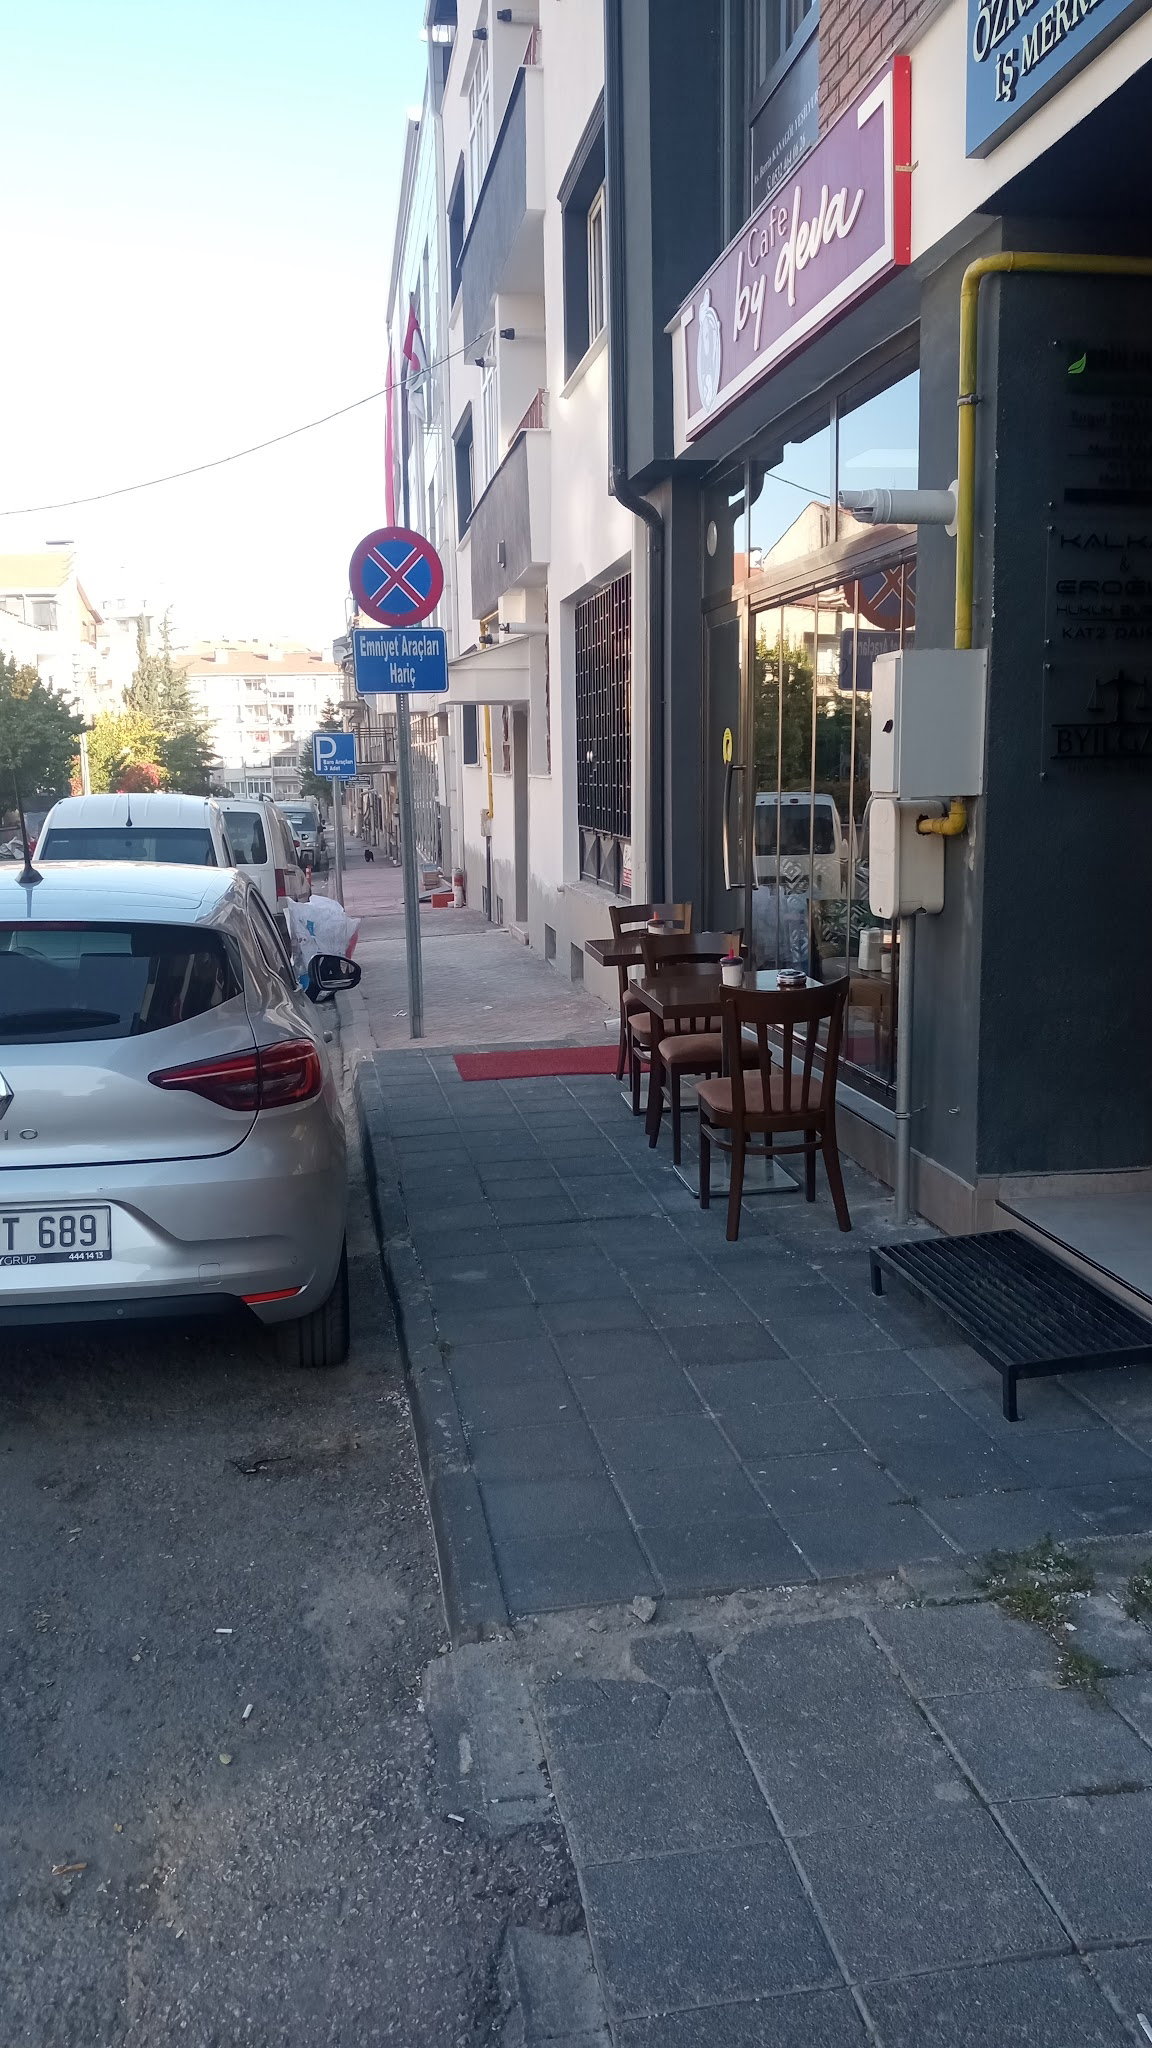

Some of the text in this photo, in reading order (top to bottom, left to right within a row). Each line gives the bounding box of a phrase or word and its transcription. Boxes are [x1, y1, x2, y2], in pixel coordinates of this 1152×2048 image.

[973, 0, 1034, 62] ÖZK
[995, 0, 1099, 103] İŞ MERK
[748, 205, 788, 268] Cafe
[732, 184, 865, 351] by deva
[1060, 533, 1152, 549] KALK
[1056, 576, 1152, 596] EROĞ
[359, 635, 439, 662] Emniyet Araçları
[390, 662, 416, 688] Hariç
[39, 1215, 96, 1248] 689
[95, 1251, 103, 1259] 13
